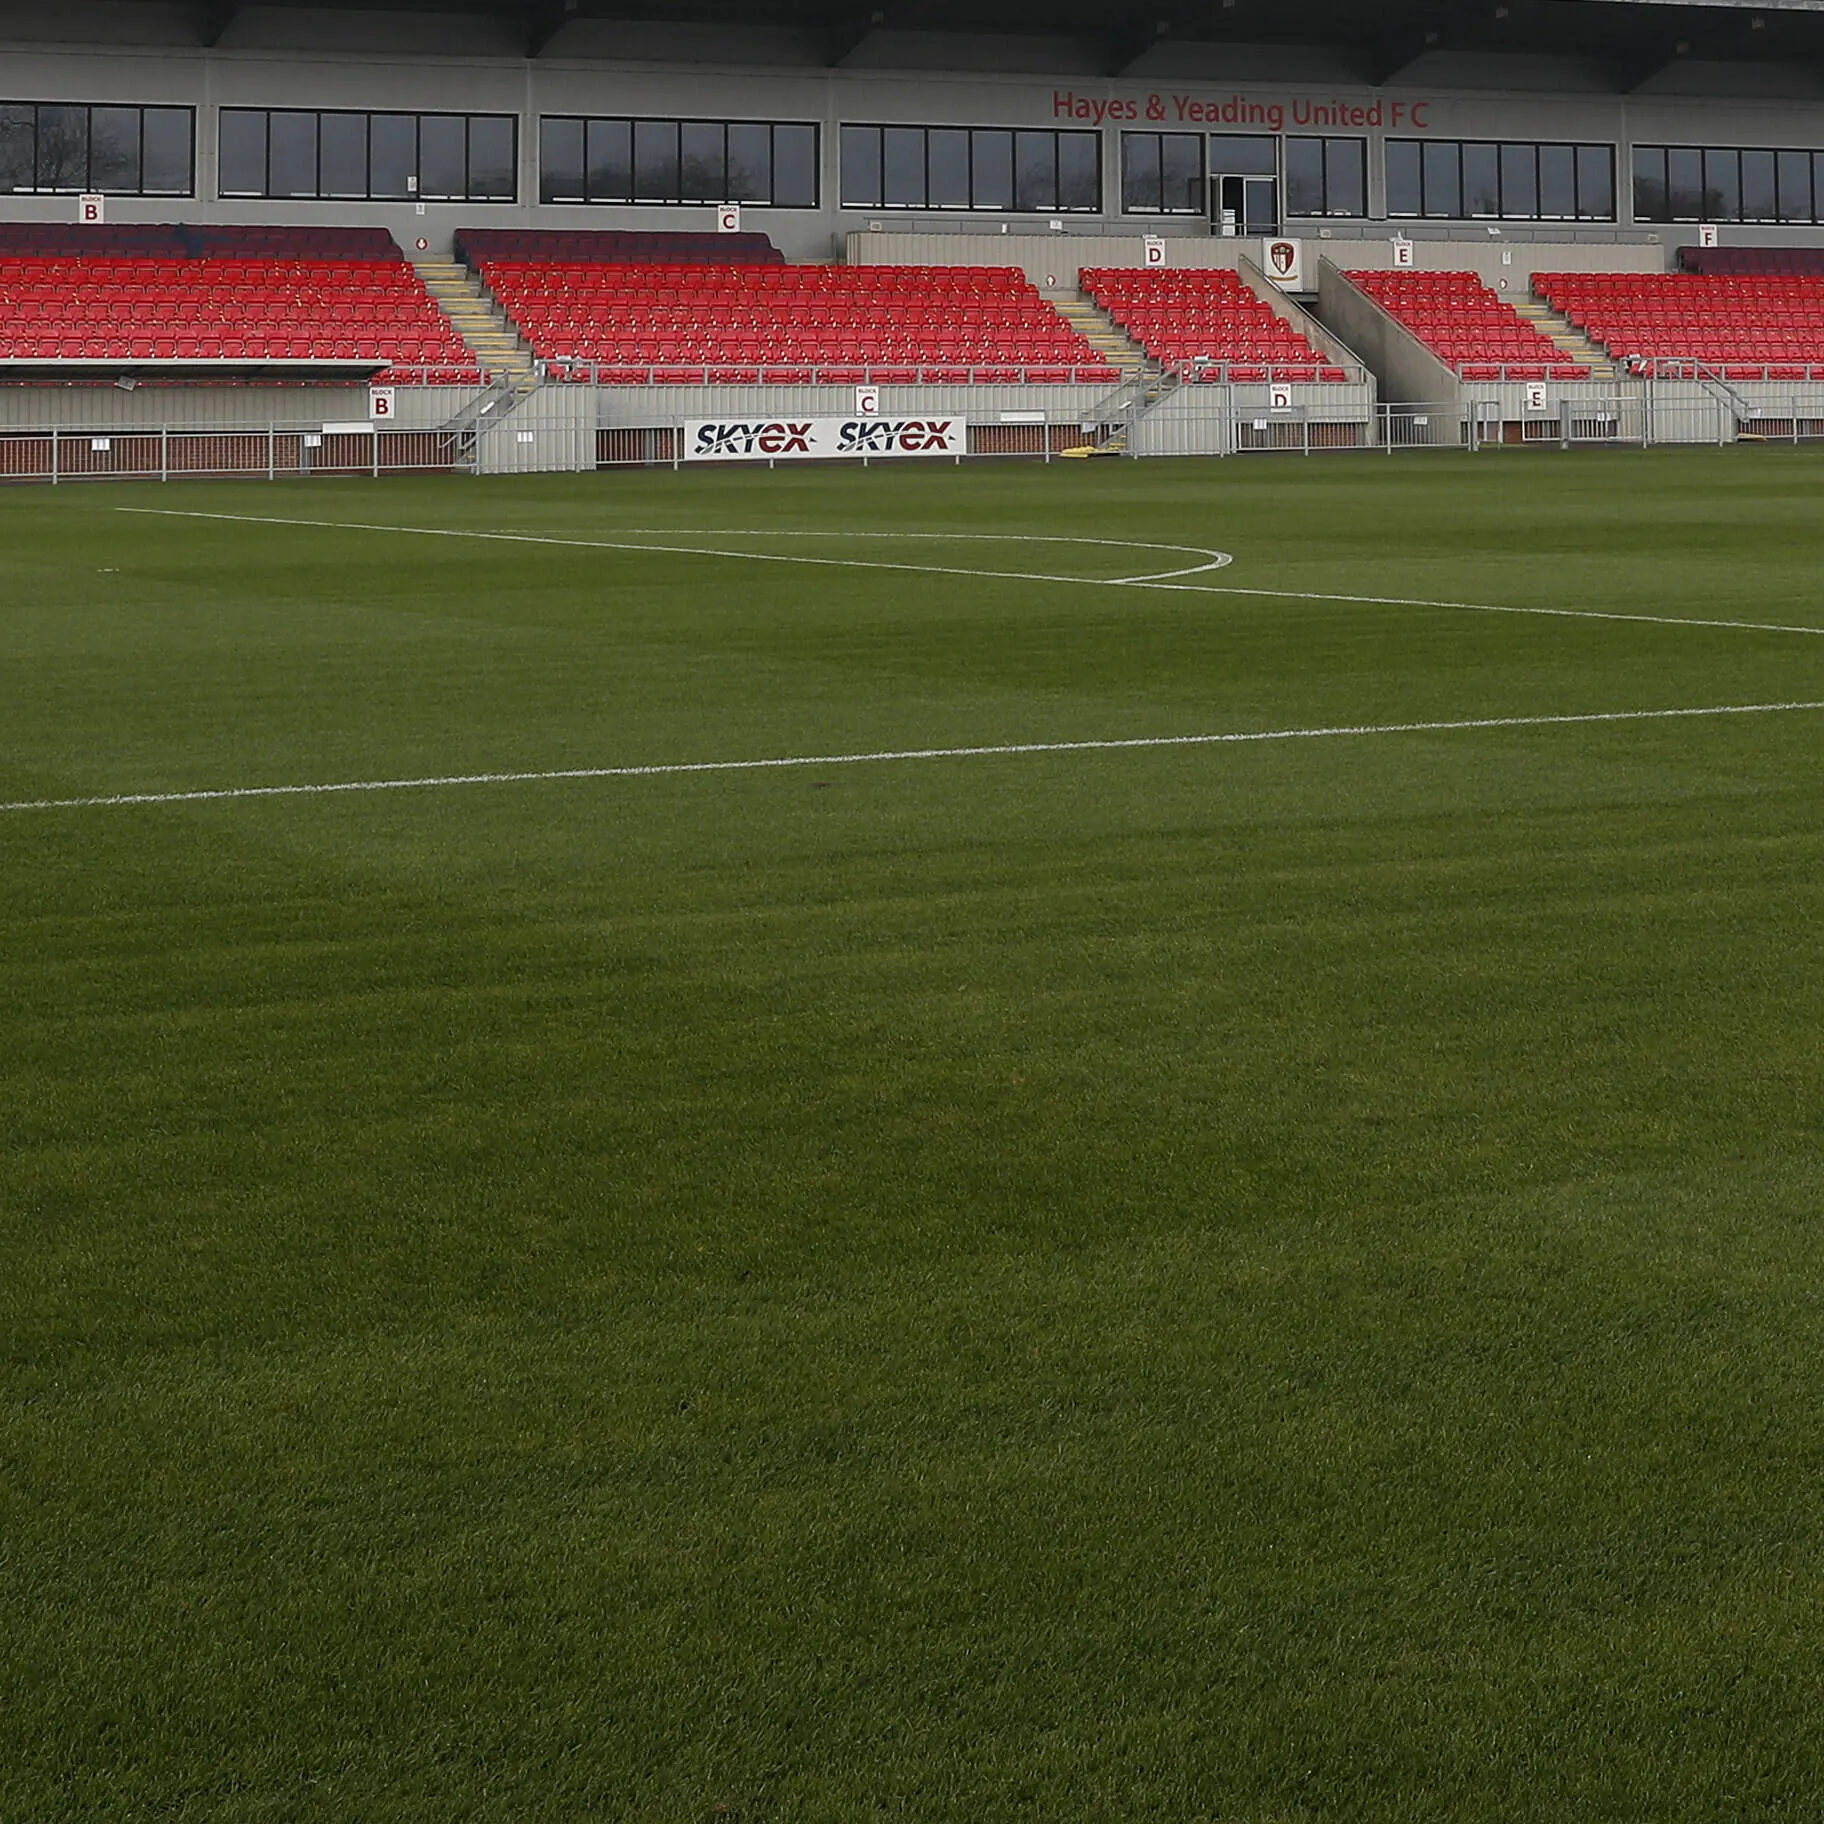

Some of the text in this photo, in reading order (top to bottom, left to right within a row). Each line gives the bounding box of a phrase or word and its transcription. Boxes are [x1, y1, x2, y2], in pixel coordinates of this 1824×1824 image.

[1053, 90, 1137, 126] Hayes
[1145, 94, 1167, 121] &
[1172, 94, 1284, 131] Yeading
[1292, 98, 1382, 127] United
[85, 204, 98, 220] B
[723, 214, 736, 229] C
[1704, 232, 1712, 246] F
[1149, 248, 1161, 262] D
[1399, 248, 1408, 263] E
[375, 398, 389, 414] B
[861, 395, 874, 412] C
[1274, 393, 1287, 408] D
[1532, 391, 1541, 407] E
